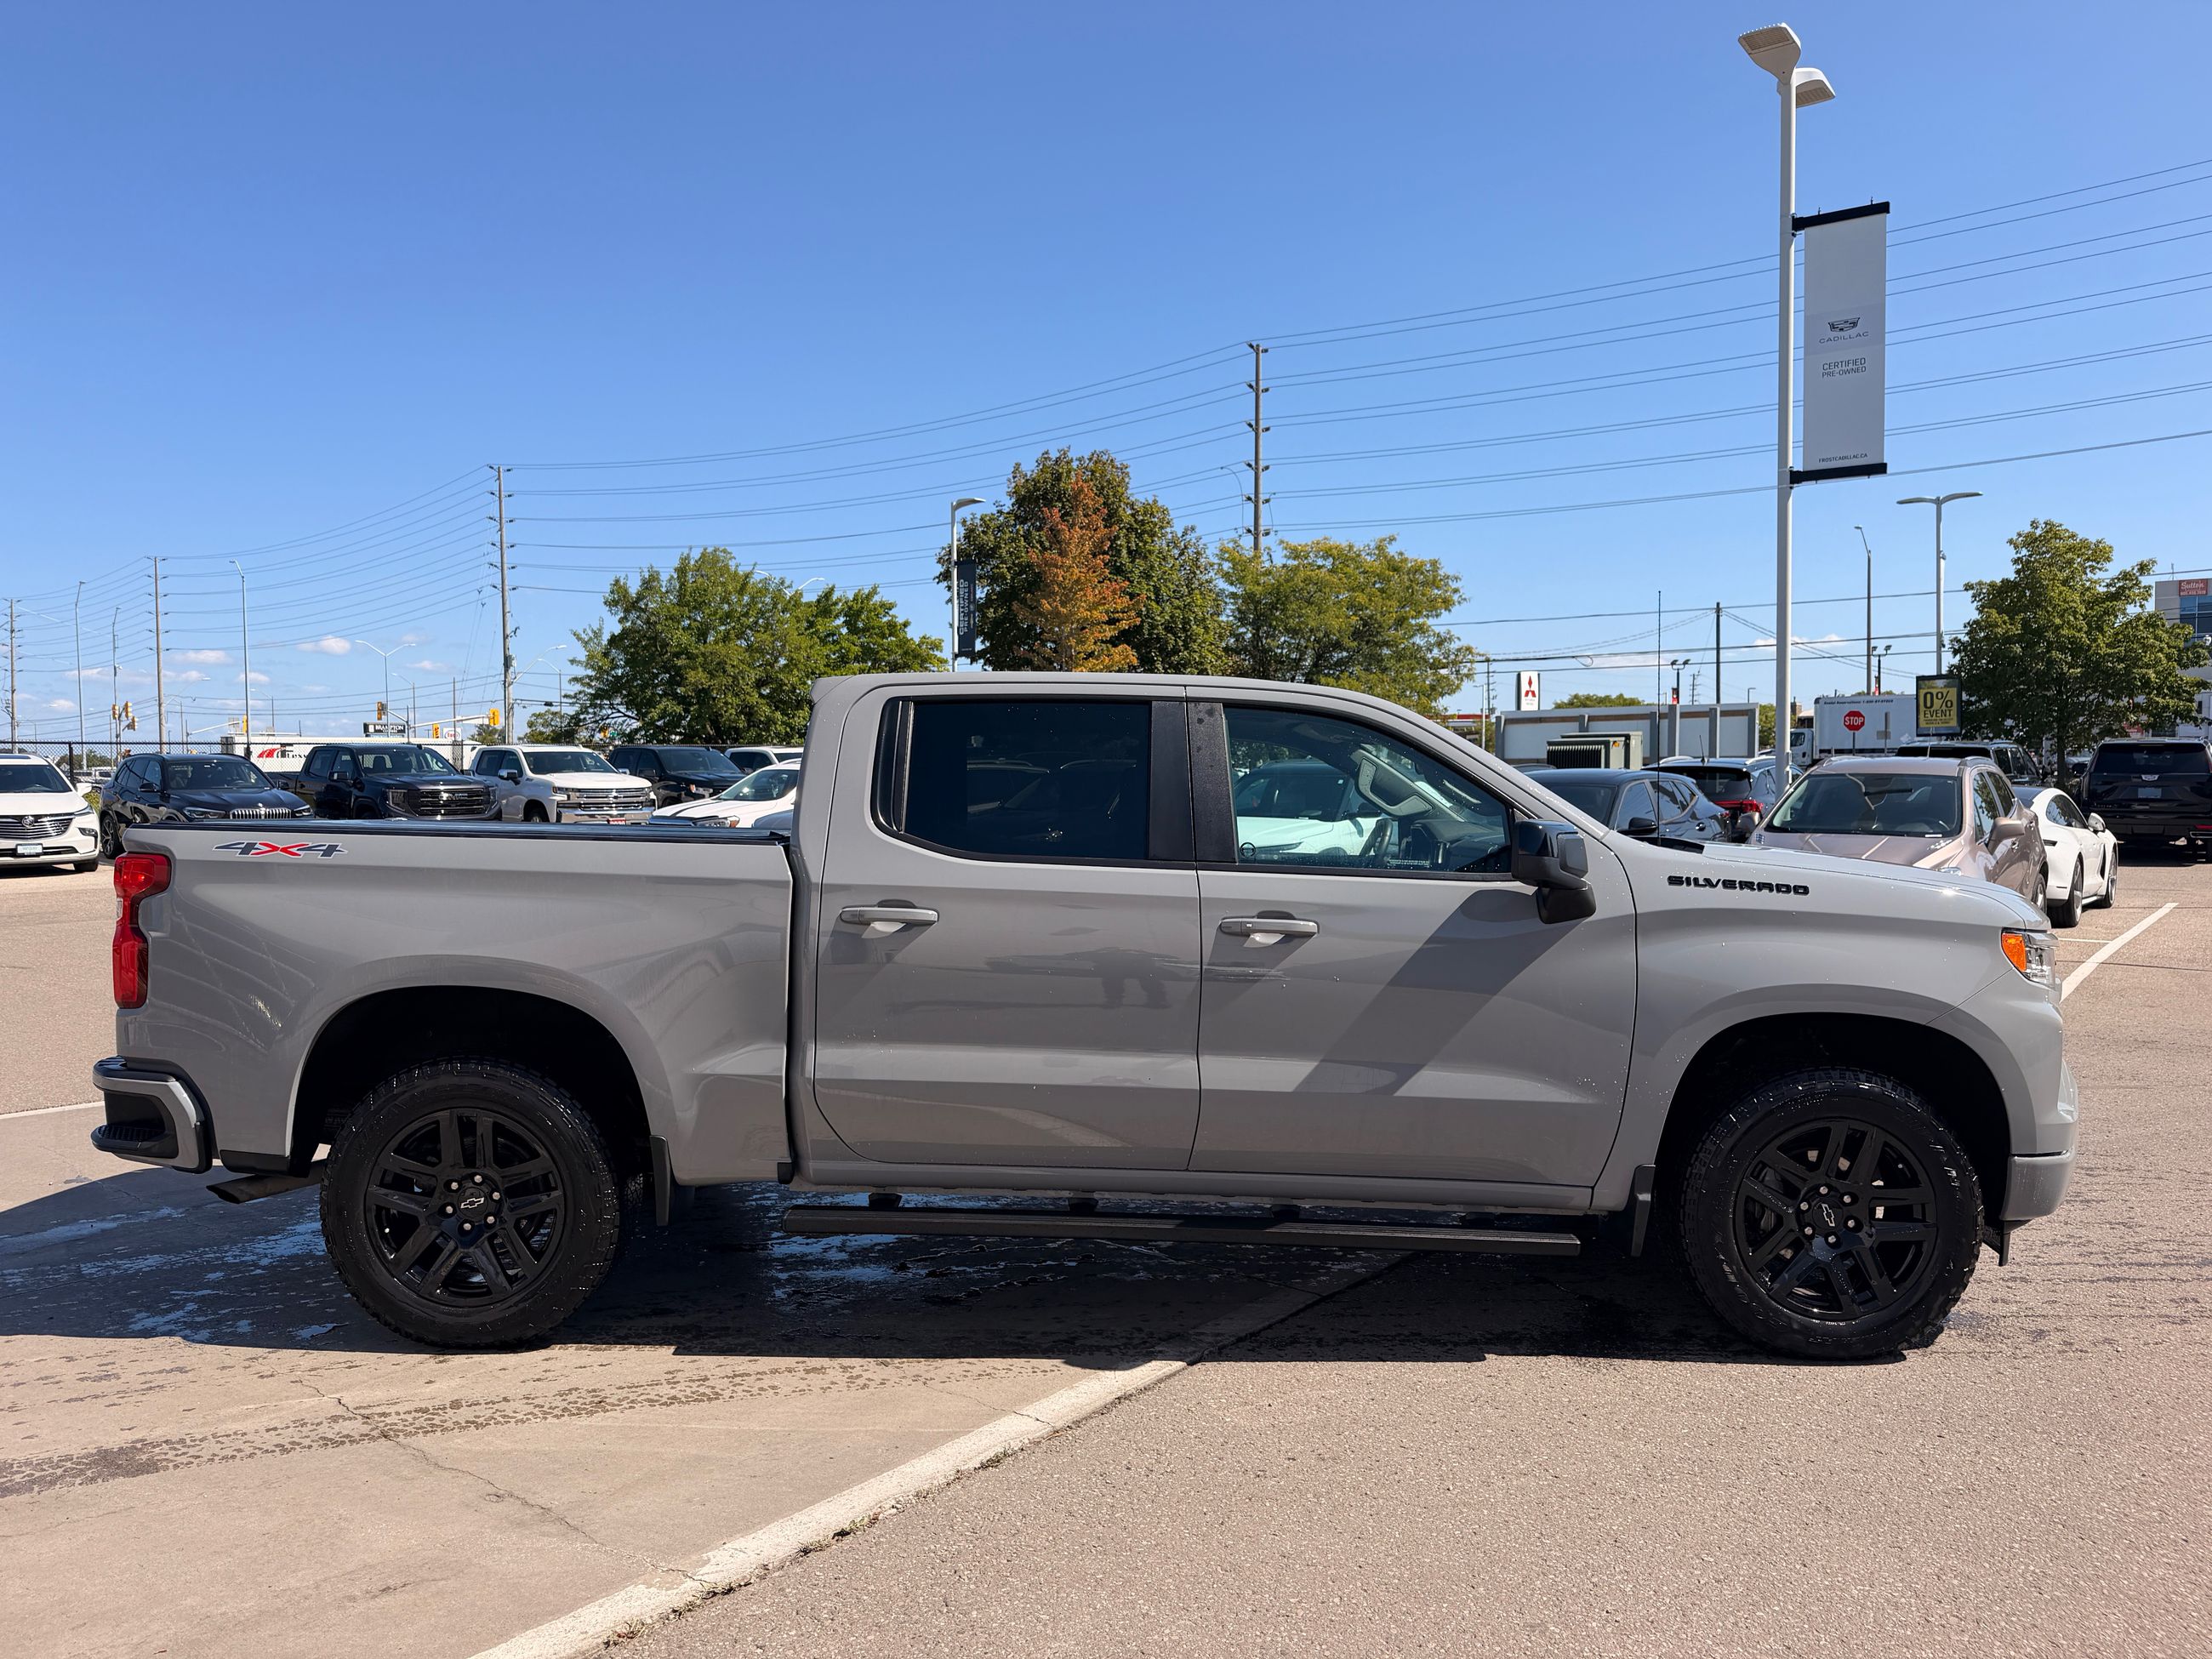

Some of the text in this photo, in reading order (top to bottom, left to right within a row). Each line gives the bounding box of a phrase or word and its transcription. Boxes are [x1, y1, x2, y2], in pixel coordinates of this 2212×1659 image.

[1819, 331, 1869, 344] CADILLAC
[1822, 357, 1866, 371] CERTIFIED
[1822, 366, 1866, 379] PRE-OWNED
[1924, 690, 1953, 710] 0%
[1924, 710, 1953, 718] EVENT
[1844, 716, 1864, 726] STOP
[1667, 875, 1810, 896] SILVERADO
